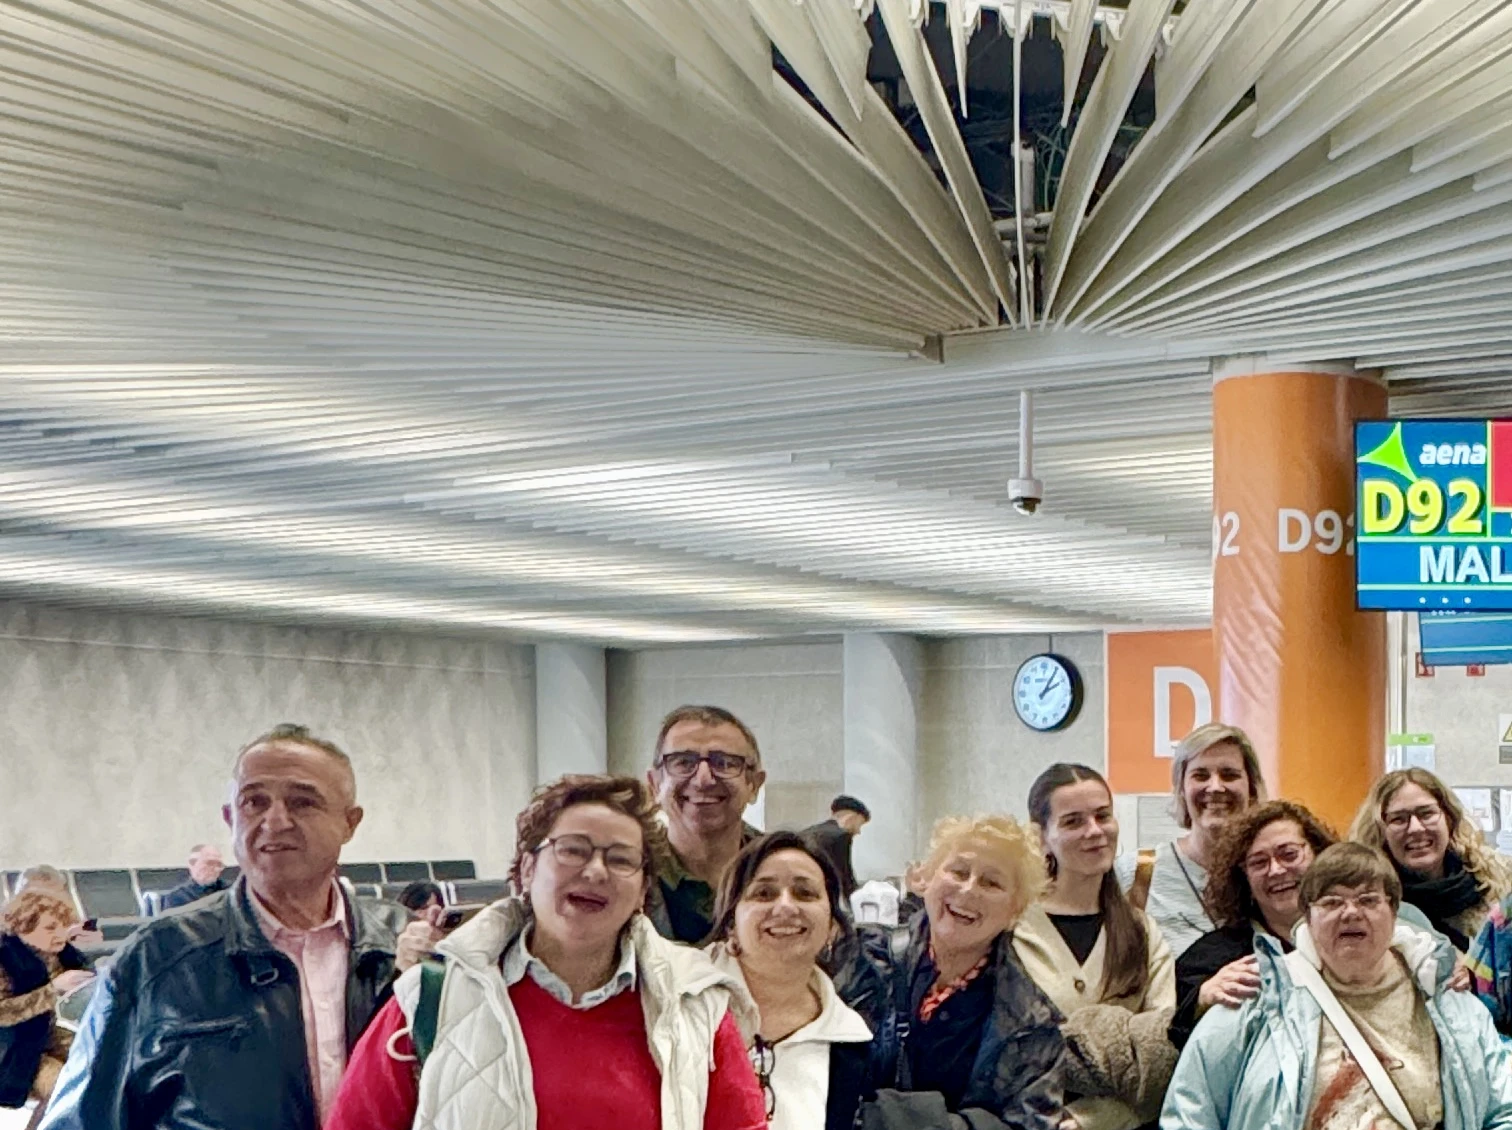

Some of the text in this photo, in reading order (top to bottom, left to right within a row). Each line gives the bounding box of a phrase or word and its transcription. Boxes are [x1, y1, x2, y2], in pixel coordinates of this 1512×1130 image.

[1419, 443, 1487, 465] aena
[1362, 479, 1483, 535] D92
[1153, 665, 1212, 758] D
